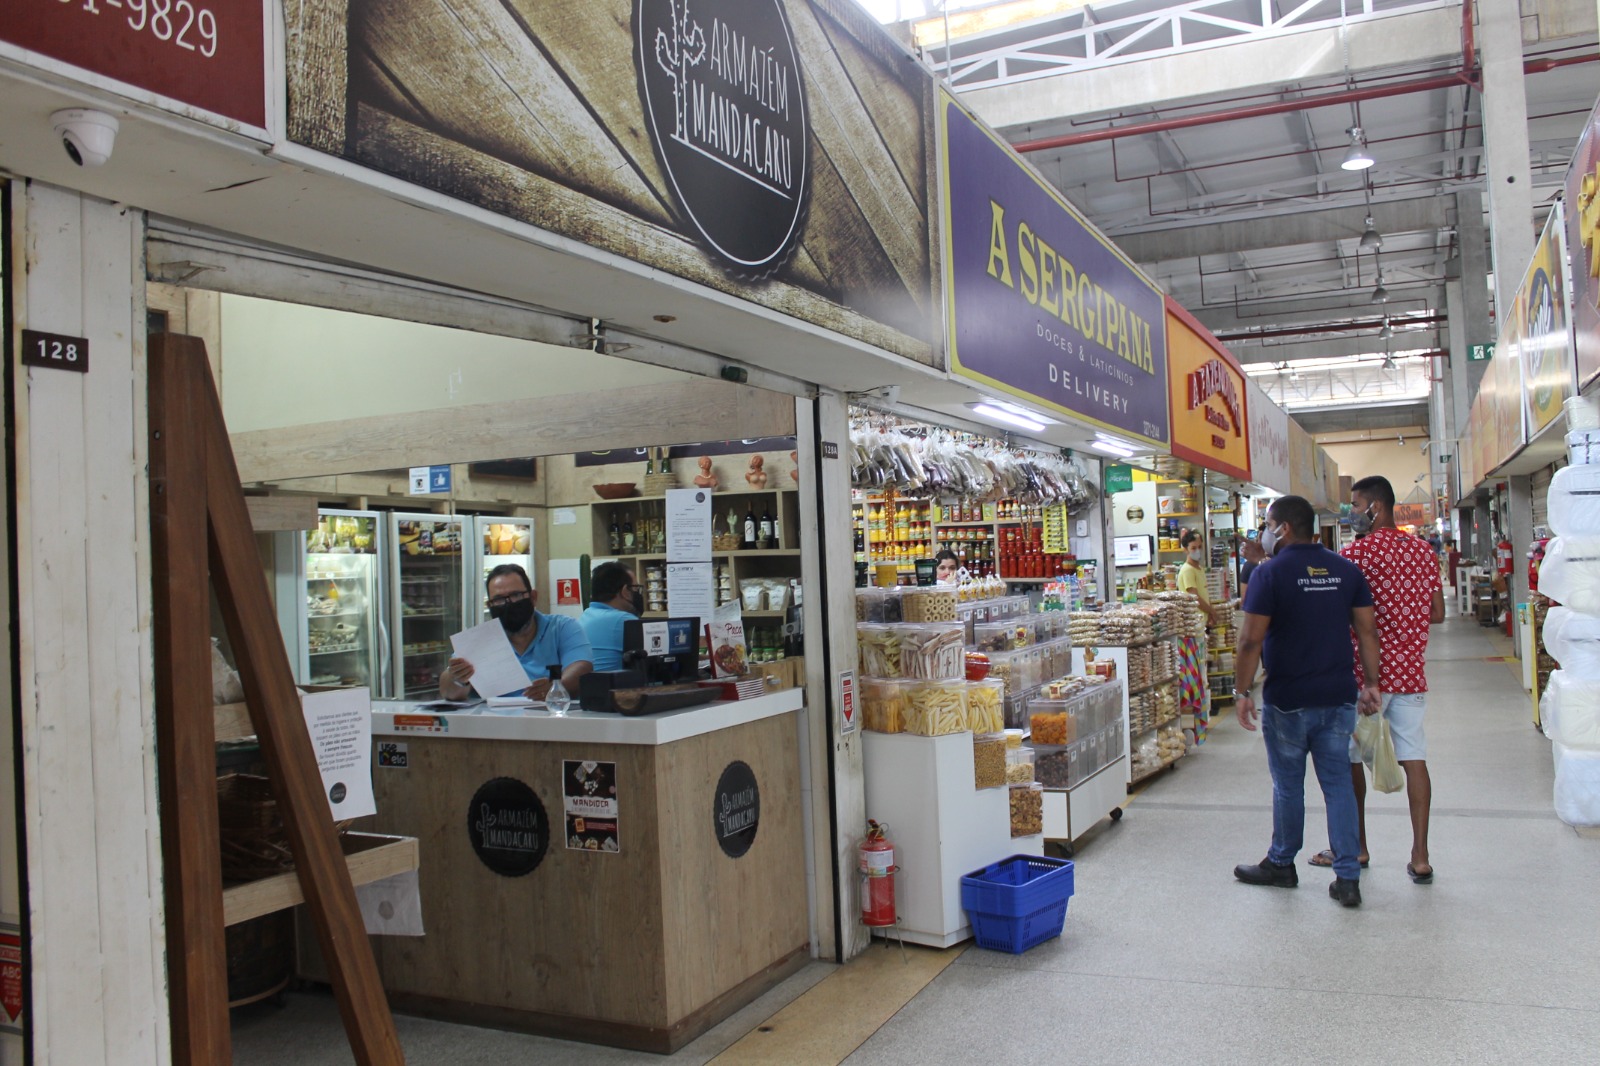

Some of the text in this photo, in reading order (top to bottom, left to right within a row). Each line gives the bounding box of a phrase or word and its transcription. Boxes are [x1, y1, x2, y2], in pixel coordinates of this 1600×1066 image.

[711, 17, 788, 121] ARMAZÉM
[693, 79, 791, 189] MANDACARU
[987, 199, 1155, 376] A SERGIPANA
[38, 339, 77, 362] 128
[1037, 323, 1134, 387] DOCES & LATICÍNIOS
[1049, 363, 1129, 414] DELIVERY
[497, 807, 538, 829] ARMAZÉM
[572, 798, 609, 808] MANDIOCA
[490, 829, 539, 850] MANDACARU
